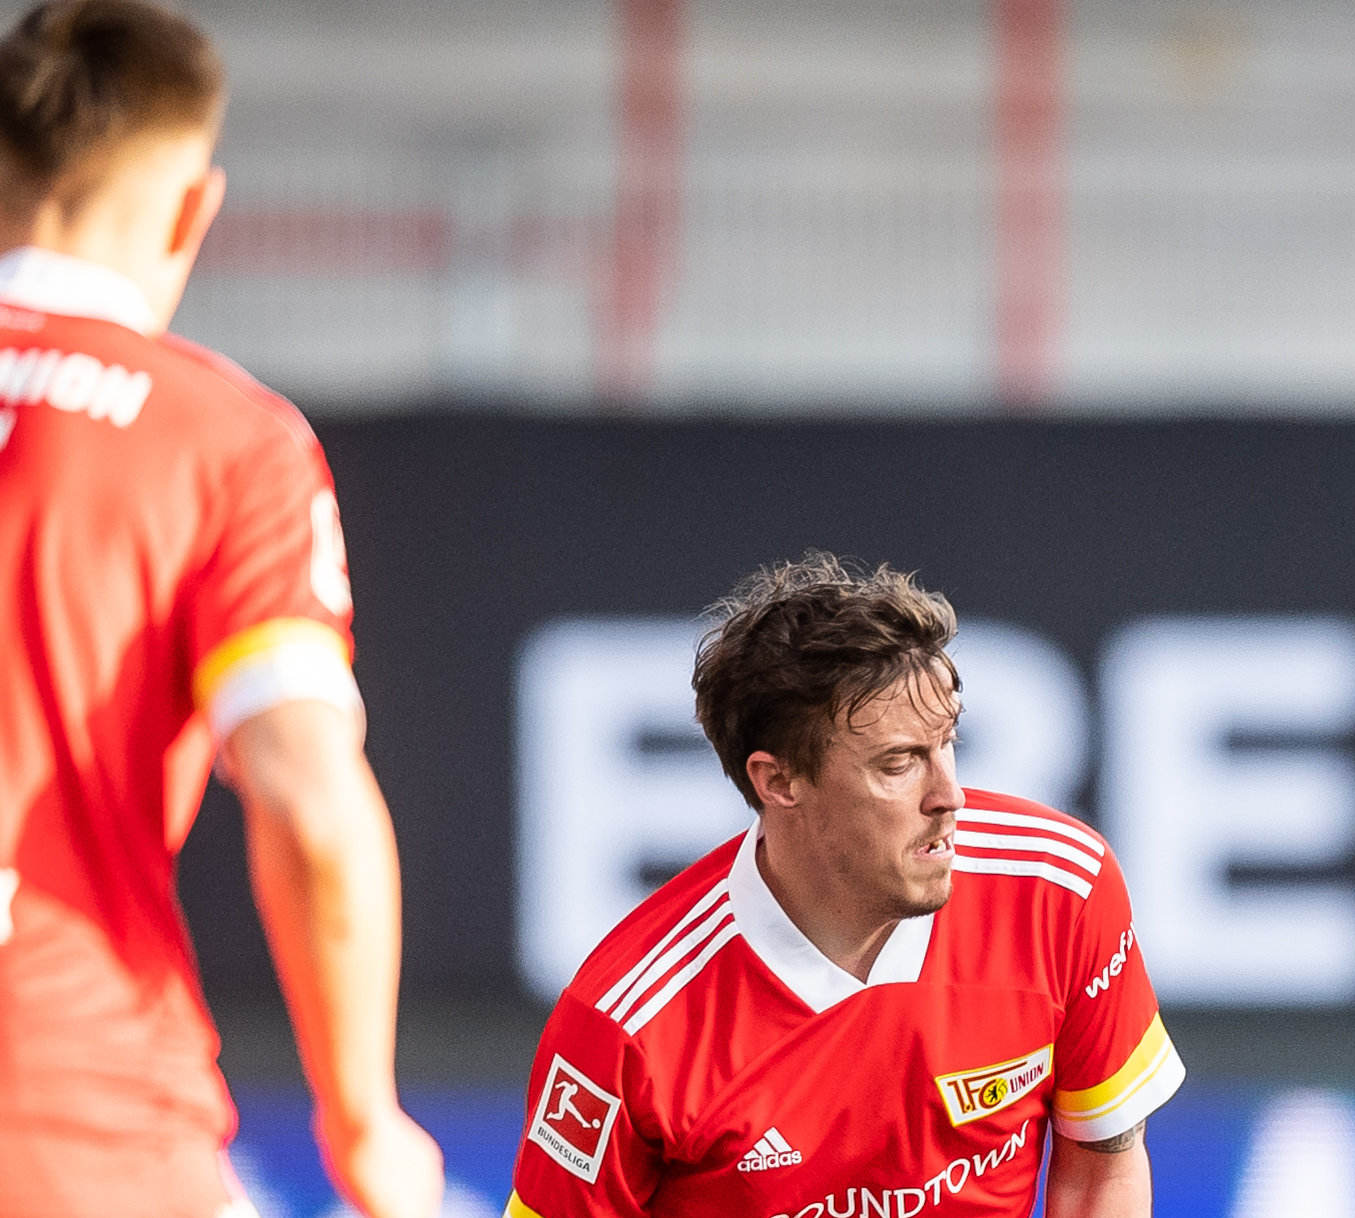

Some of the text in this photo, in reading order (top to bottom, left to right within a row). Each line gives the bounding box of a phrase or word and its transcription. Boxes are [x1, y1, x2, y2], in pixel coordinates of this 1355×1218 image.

[1010, 1062, 1044, 1094] UNION
[537, 1126, 591, 1173] BUNDESLIGA
[736, 1149, 803, 1172] adidas
